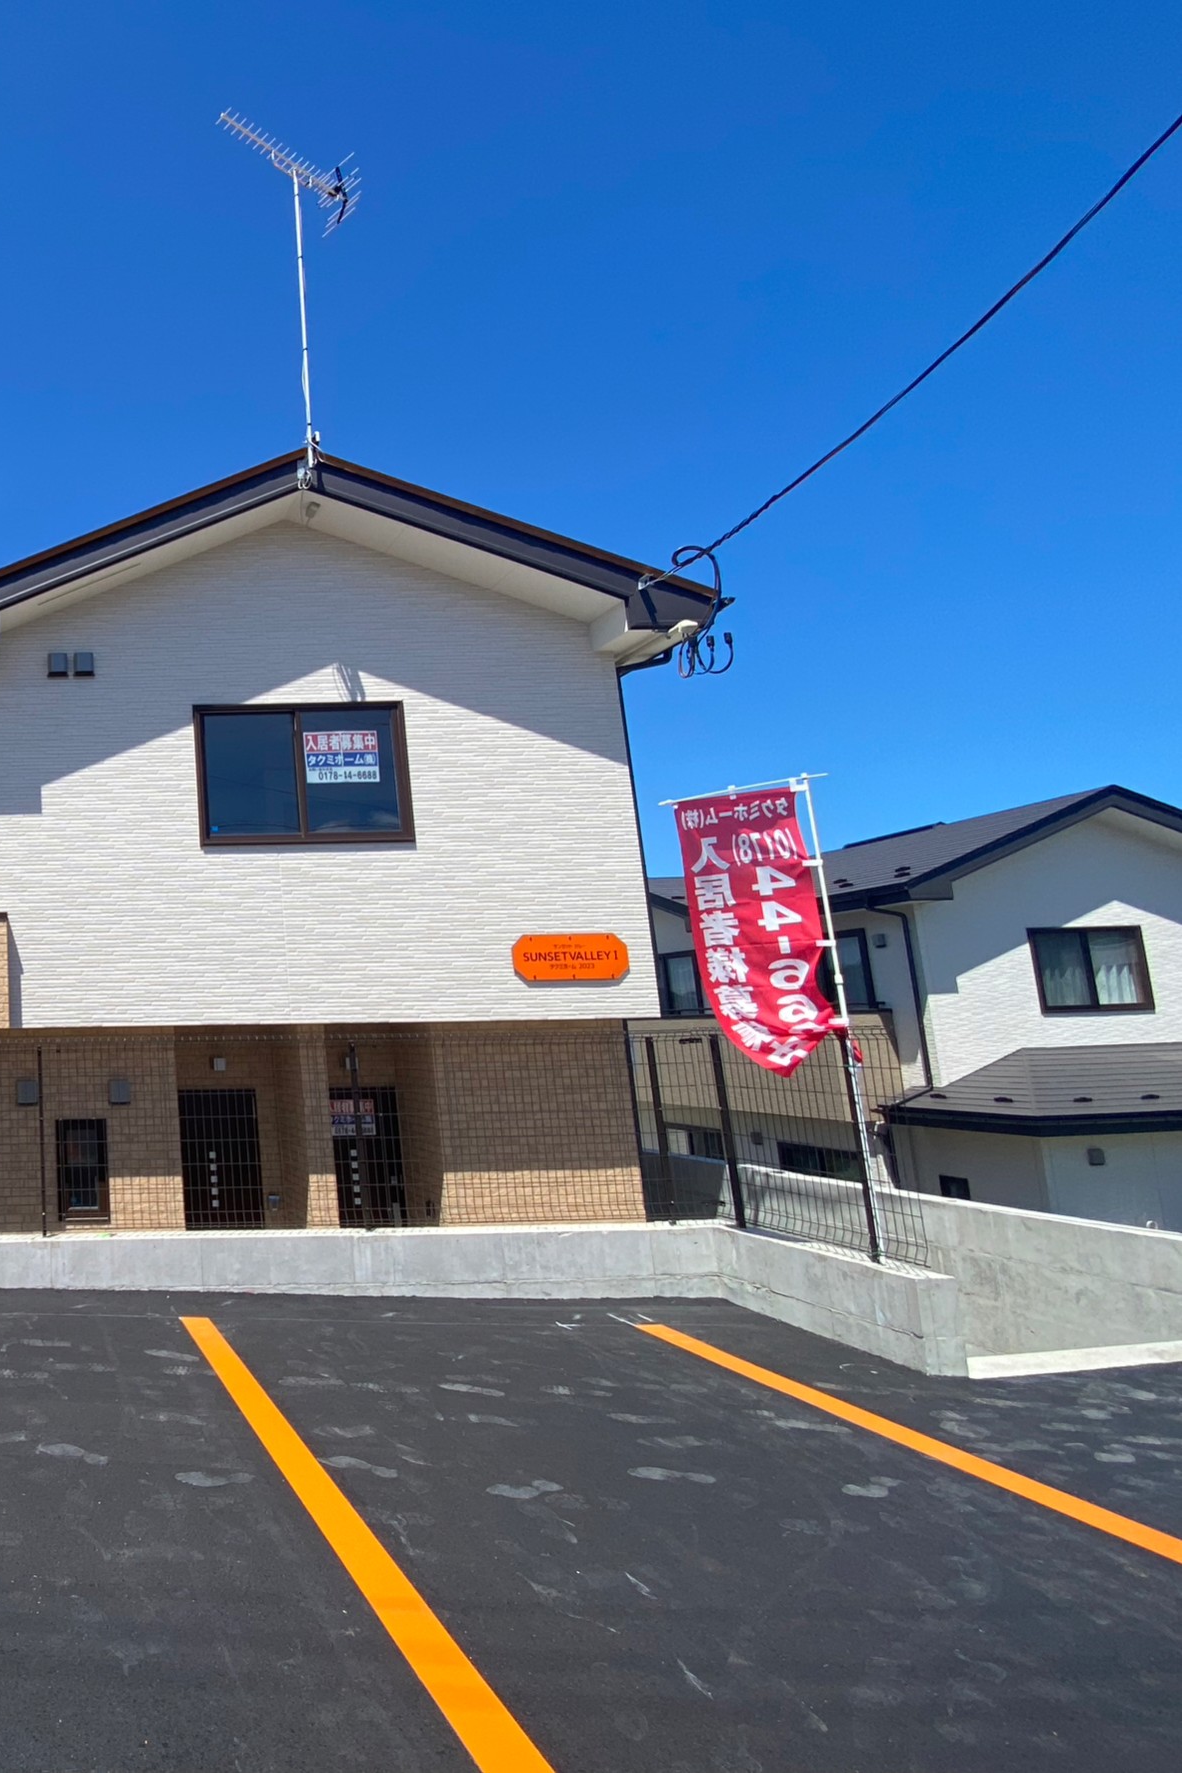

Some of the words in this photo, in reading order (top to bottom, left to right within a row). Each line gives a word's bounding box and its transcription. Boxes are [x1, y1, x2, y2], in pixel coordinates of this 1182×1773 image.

[306, 734, 375, 751] 入居者募集中
[523, 951, 611, 962] SUNSETVALLEY
